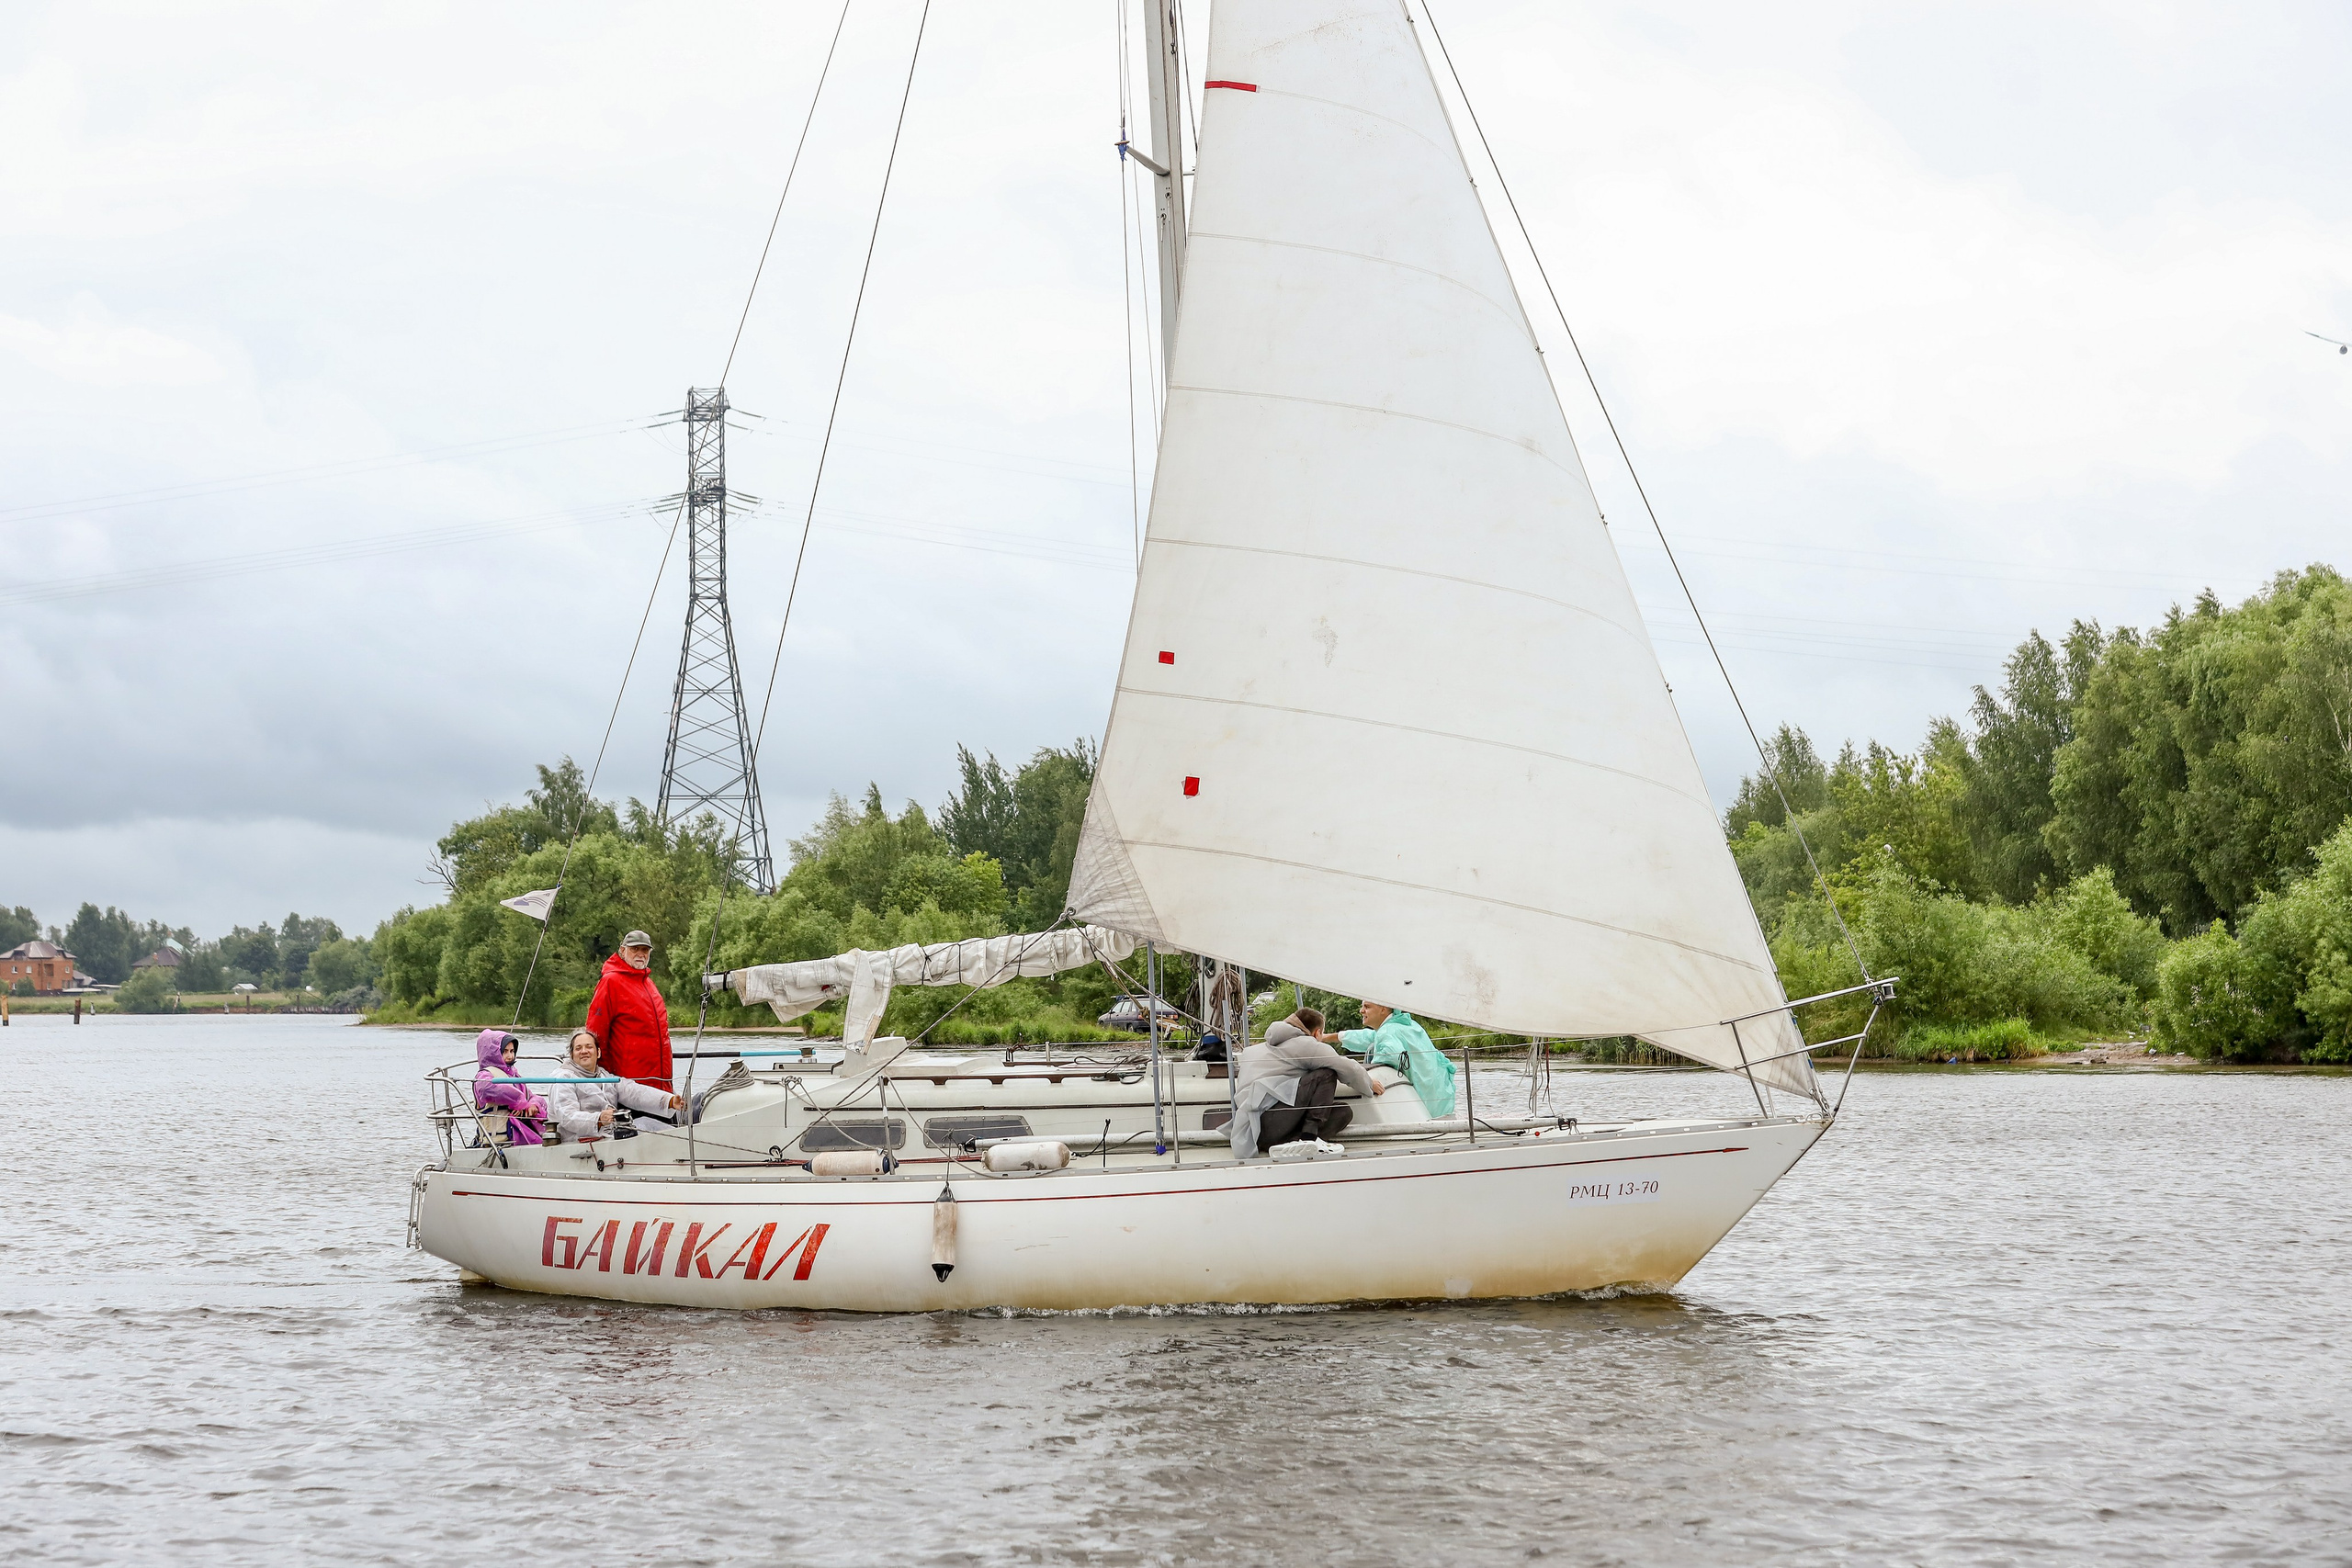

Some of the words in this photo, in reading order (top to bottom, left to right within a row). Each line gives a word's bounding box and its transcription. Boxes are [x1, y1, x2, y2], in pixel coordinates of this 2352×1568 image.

[1569, 1183, 1611, 1200] РМЦ
[1618, 1180, 1659, 1196] 13-70
[542, 1215, 831, 1280] БАЙКАЛ
